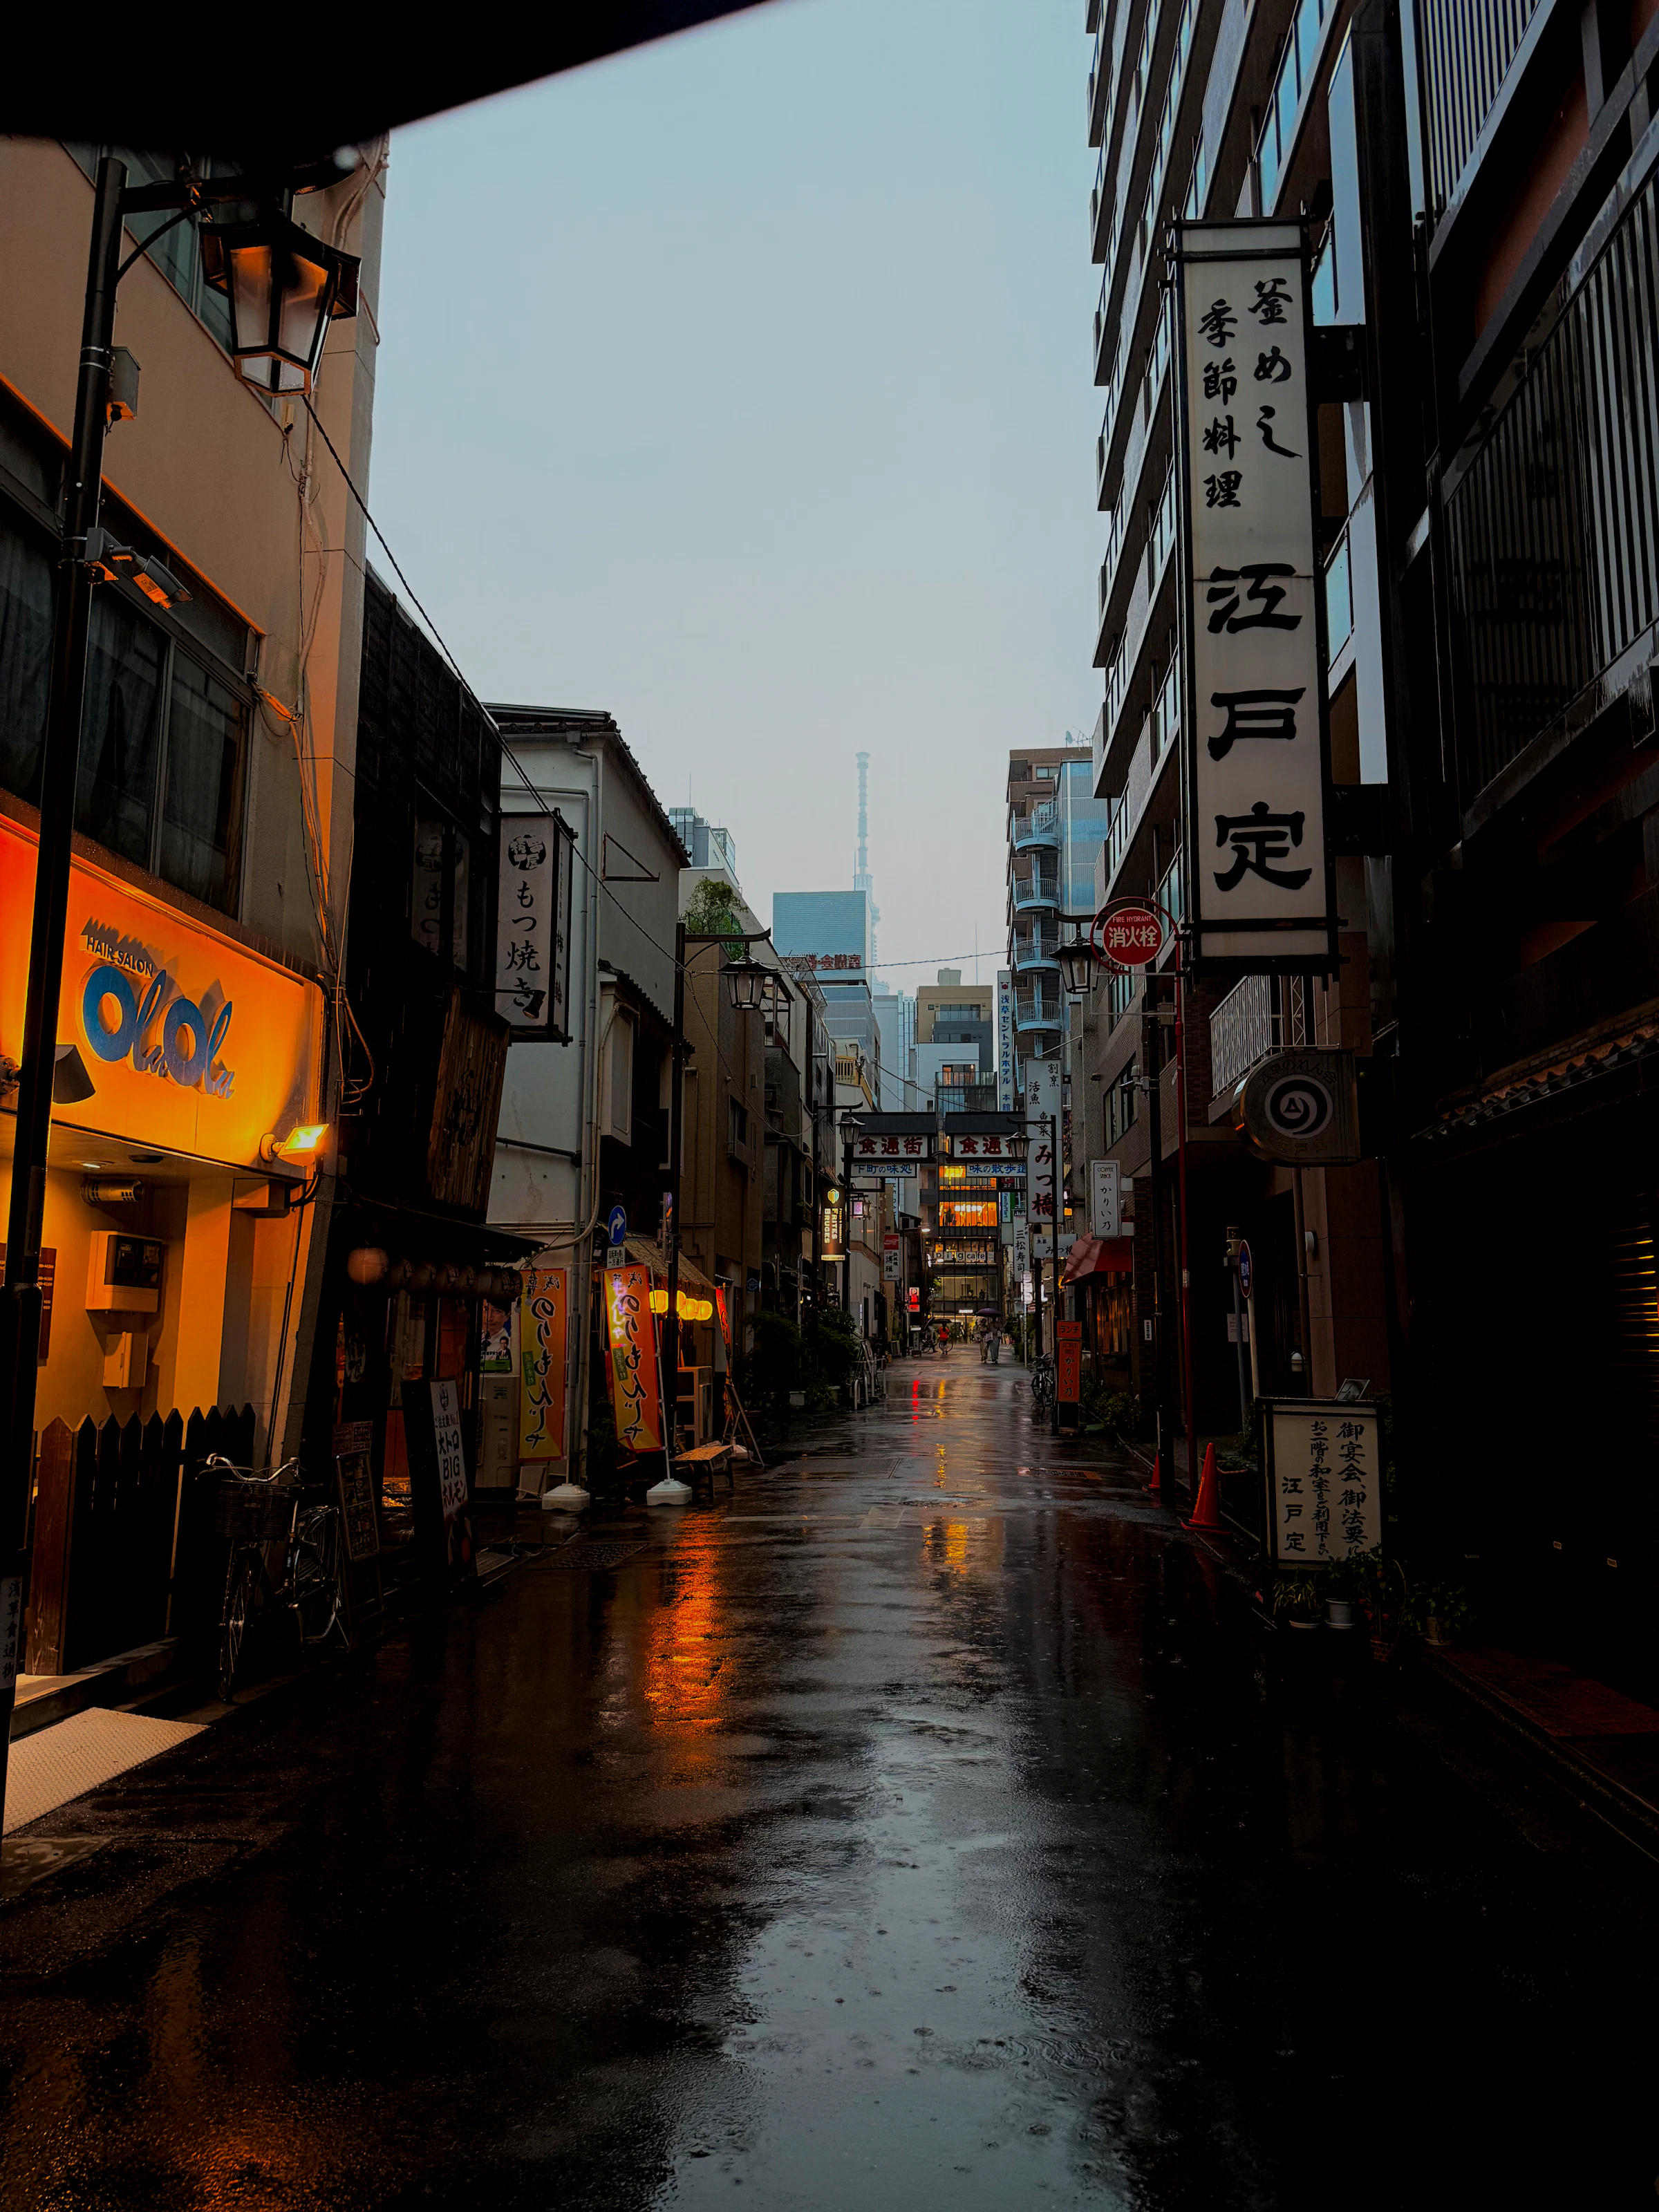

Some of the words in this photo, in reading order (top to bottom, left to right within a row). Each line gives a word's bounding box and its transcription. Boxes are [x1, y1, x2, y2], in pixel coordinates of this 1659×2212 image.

[1248, 279, 1302, 458] 釜めし
[1197, 299, 1243, 509] 季節料理
[1208, 563, 1312, 892] 江戸定
[505, 880, 541, 1007] もつ焼き
[1108, 925, 1159, 948] 消火栓
[86, 935, 113, 962] HAIR
[112, 949, 153, 979] SALON
[1001, 994, 1011, 1085] 浅草セントラルホテル
[1047, 1063, 1060, 1087] 割烹
[1257, 1058, 1337, 1085] 浅草のれん会
[1002, 1093, 1011, 1112] 本館
[1029, 1081, 1041, 1105] 活魚
[858, 1136, 924, 1155] 食通街
[959, 1136, 1013, 1155] 食通
[854, 1163, 912, 1174] 下町の味処
[1031, 1144, 1054, 1217] みつ橋
[1100, 1186, 1112, 1230] かりい乃
[966, 1251, 986, 1259] cafe
[1015, 1229, 1026, 1272] 三松寿司
[1060, 1325, 1080, 1334] ランチ
[1063, 1356, 1076, 1397] かりい乃
[442, 1455, 460, 1481] BIG
